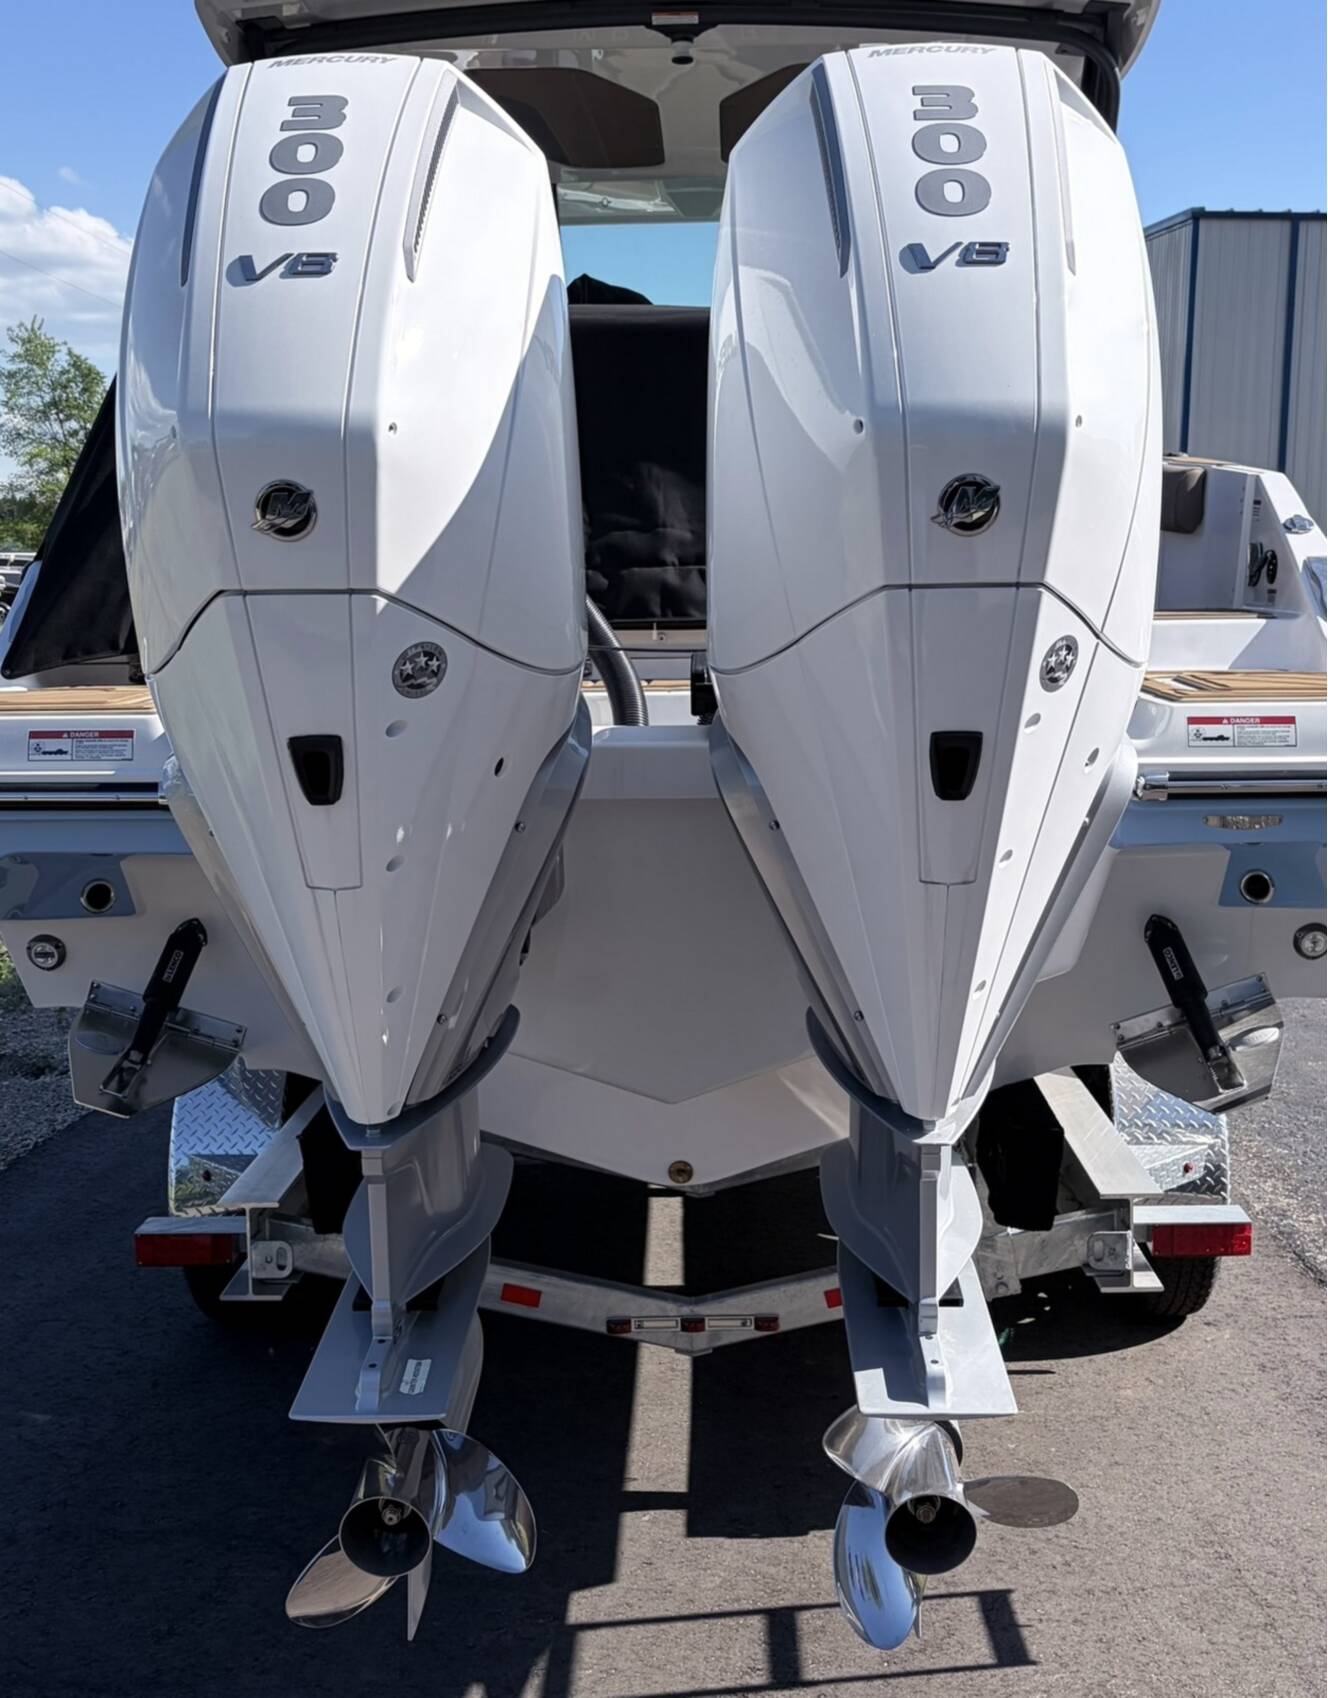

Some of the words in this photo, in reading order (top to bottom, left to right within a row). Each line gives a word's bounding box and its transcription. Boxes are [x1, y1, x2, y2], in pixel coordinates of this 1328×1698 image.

[267, 55, 398, 69] MERCURY
[867, 45, 996, 58] MERCURY
[259, 95, 349, 227] 300
[911, 85, 992, 218] 300
